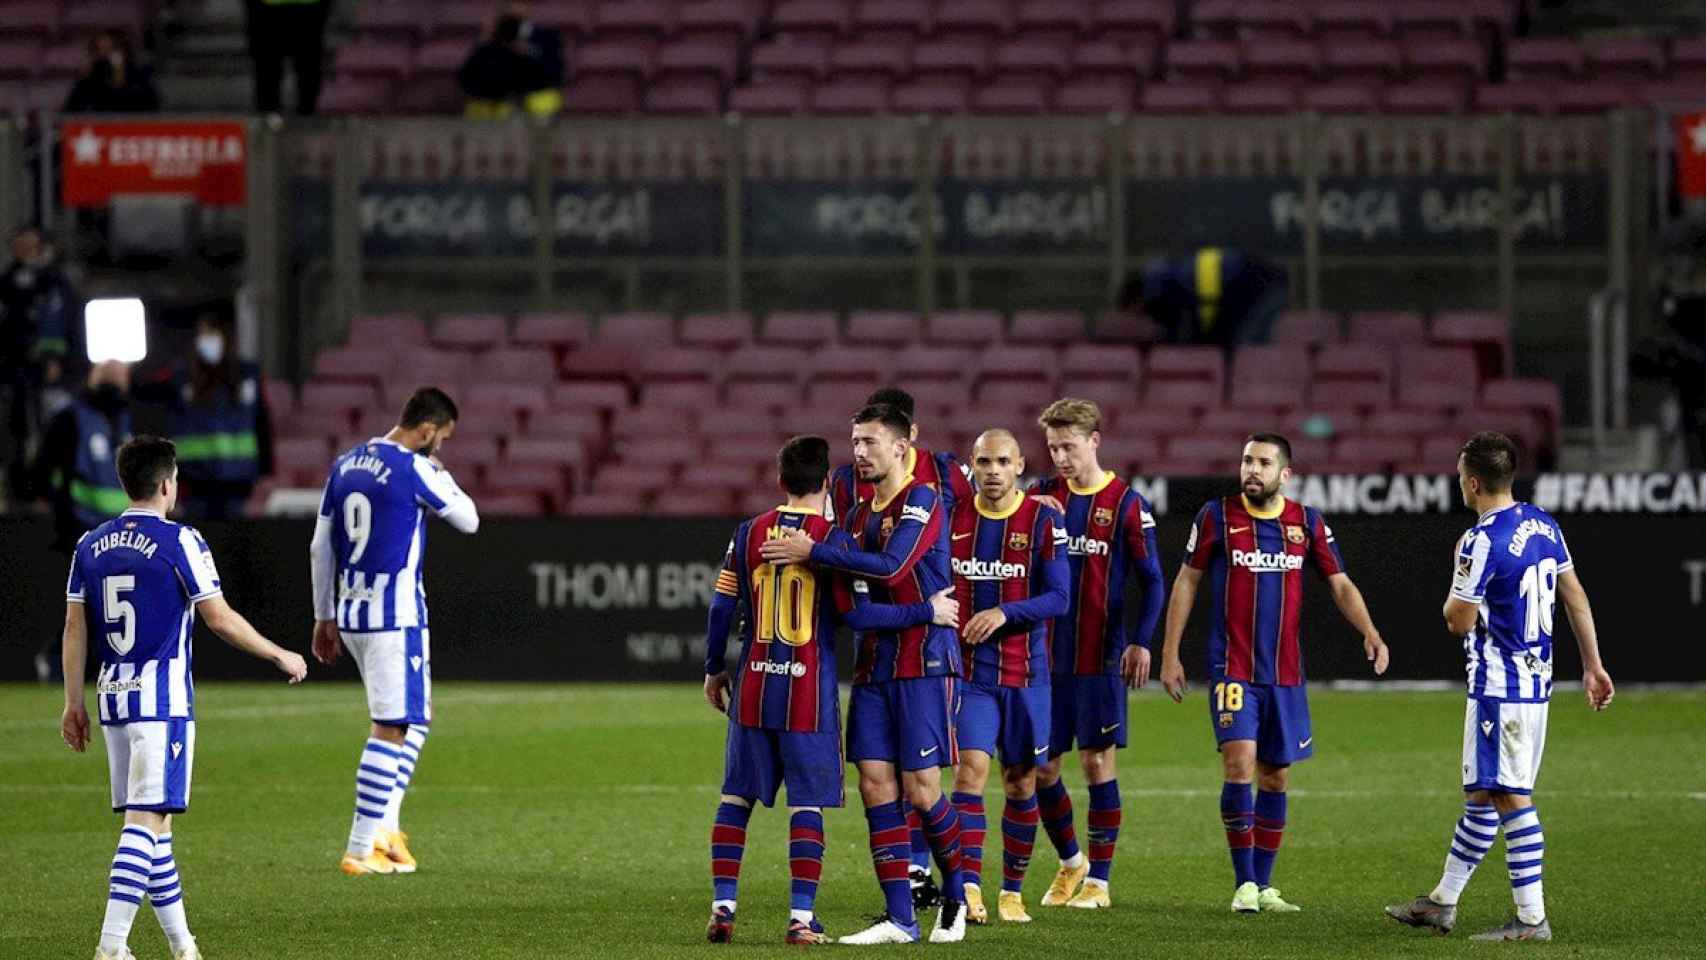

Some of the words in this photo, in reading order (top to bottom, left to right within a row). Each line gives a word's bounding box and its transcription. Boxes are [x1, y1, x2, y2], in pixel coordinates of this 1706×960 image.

[91, 530, 158, 560] ZUBELDIA
[343, 490, 371, 564] 9
[530, 561, 650, 609] THOM
[951, 557, 1026, 579] Rakuten
[103, 575, 136, 657] 5
[752, 560, 816, 646] 10
[1519, 557, 1558, 643] 18
[751, 660, 791, 675] unicef
[1215, 681, 1244, 711] 18
